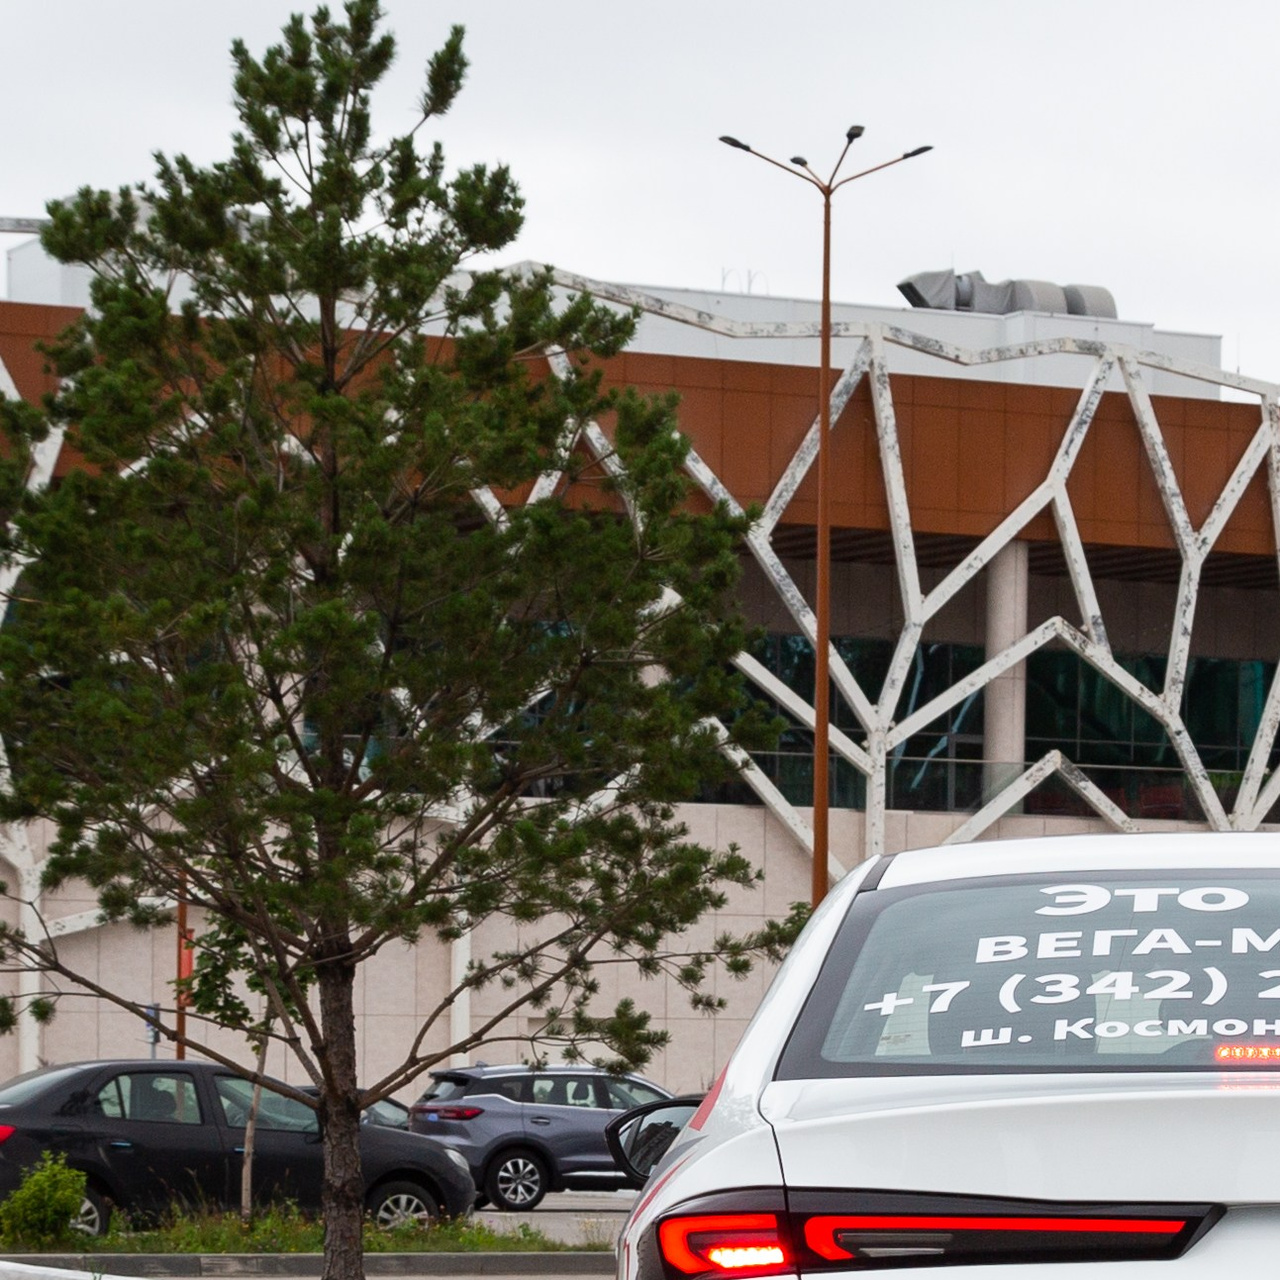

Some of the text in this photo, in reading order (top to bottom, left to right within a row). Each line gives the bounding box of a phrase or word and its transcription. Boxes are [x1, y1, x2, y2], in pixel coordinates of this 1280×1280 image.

[1035, 884, 1249, 916] Это
[863, 981, 970, 1015] +7
[999, 967, 1228, 1013] (342)
[961, 1027, 1032, 1047] ш.
